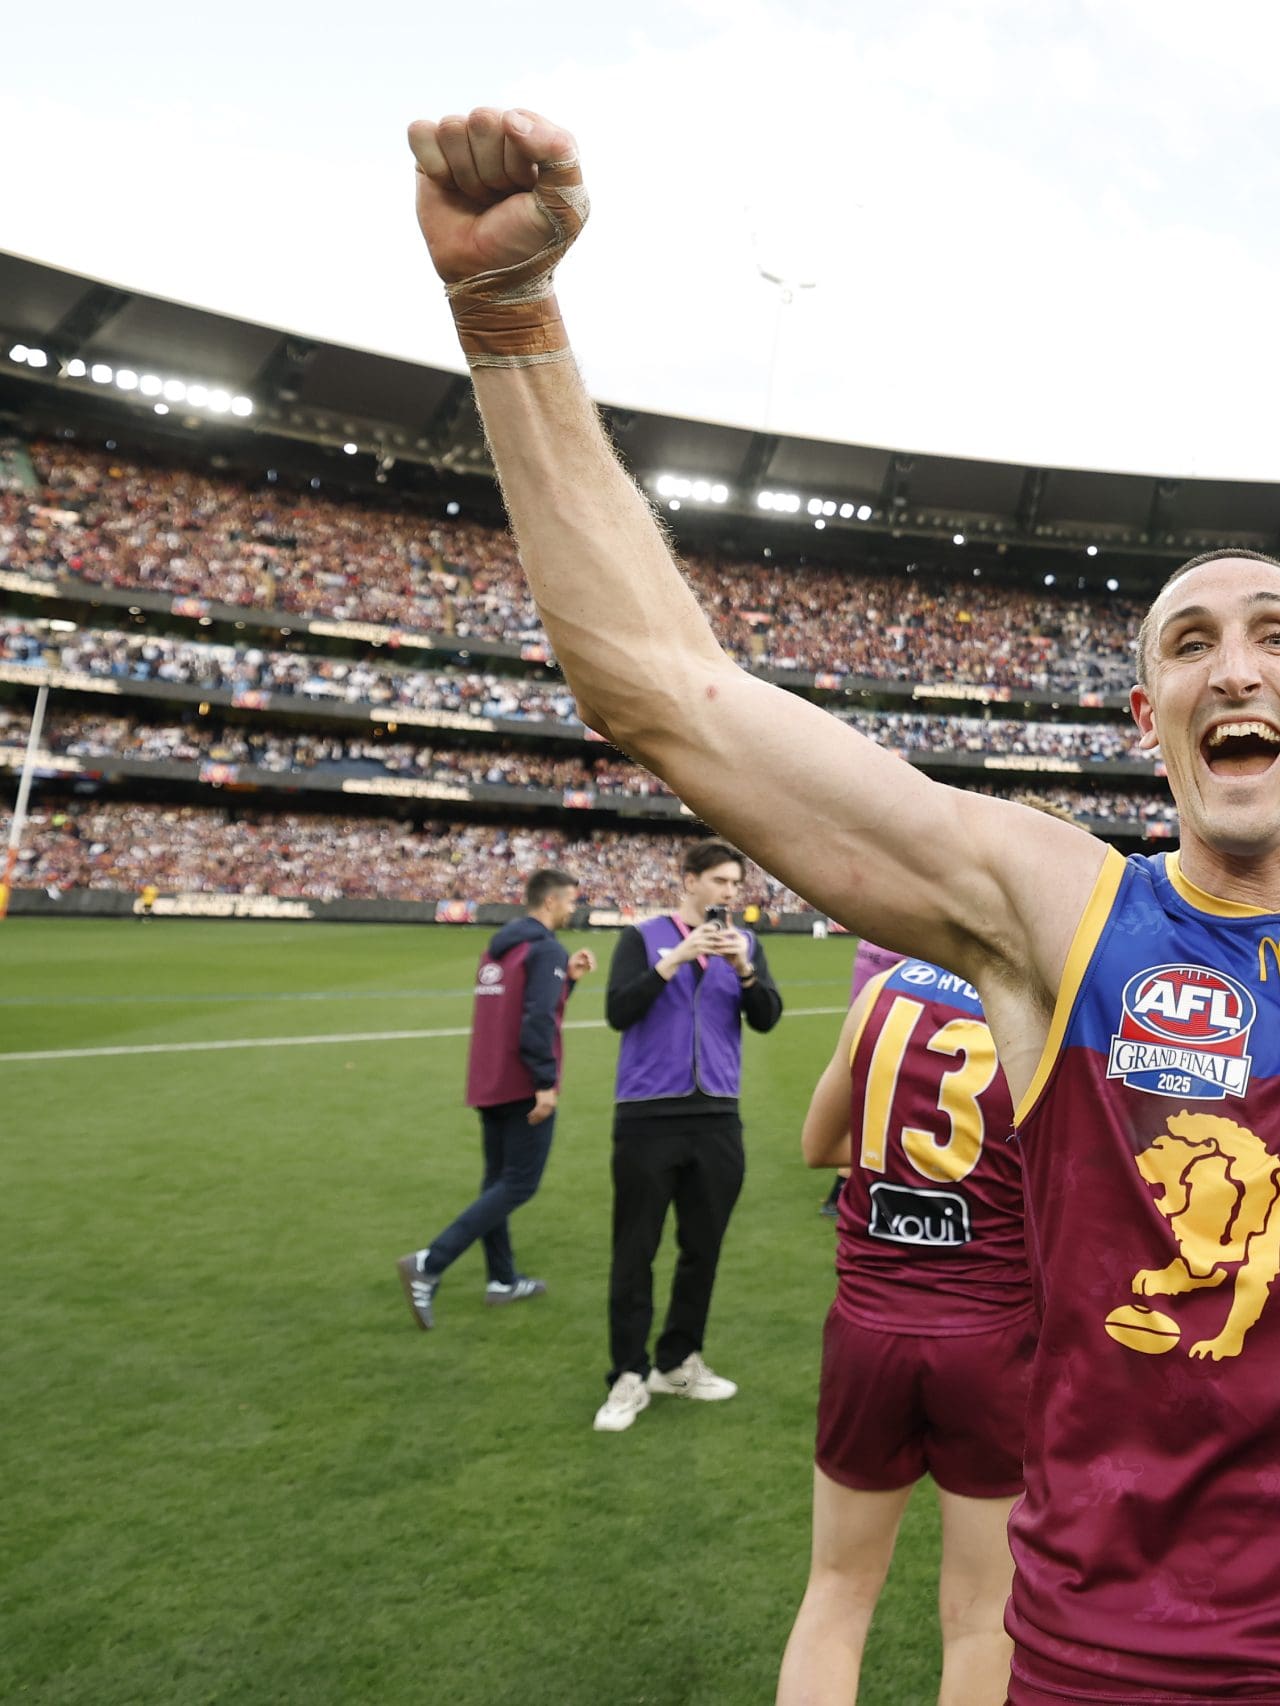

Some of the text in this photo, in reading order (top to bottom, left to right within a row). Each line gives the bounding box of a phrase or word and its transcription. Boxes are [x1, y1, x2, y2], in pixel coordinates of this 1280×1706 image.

[1132, 979, 1241, 1030] AFL
[860, 996, 999, 1183] 13
[1115, 1043, 1240, 1089] GRAND FINAL
[1157, 1073, 1192, 1093] 2025
